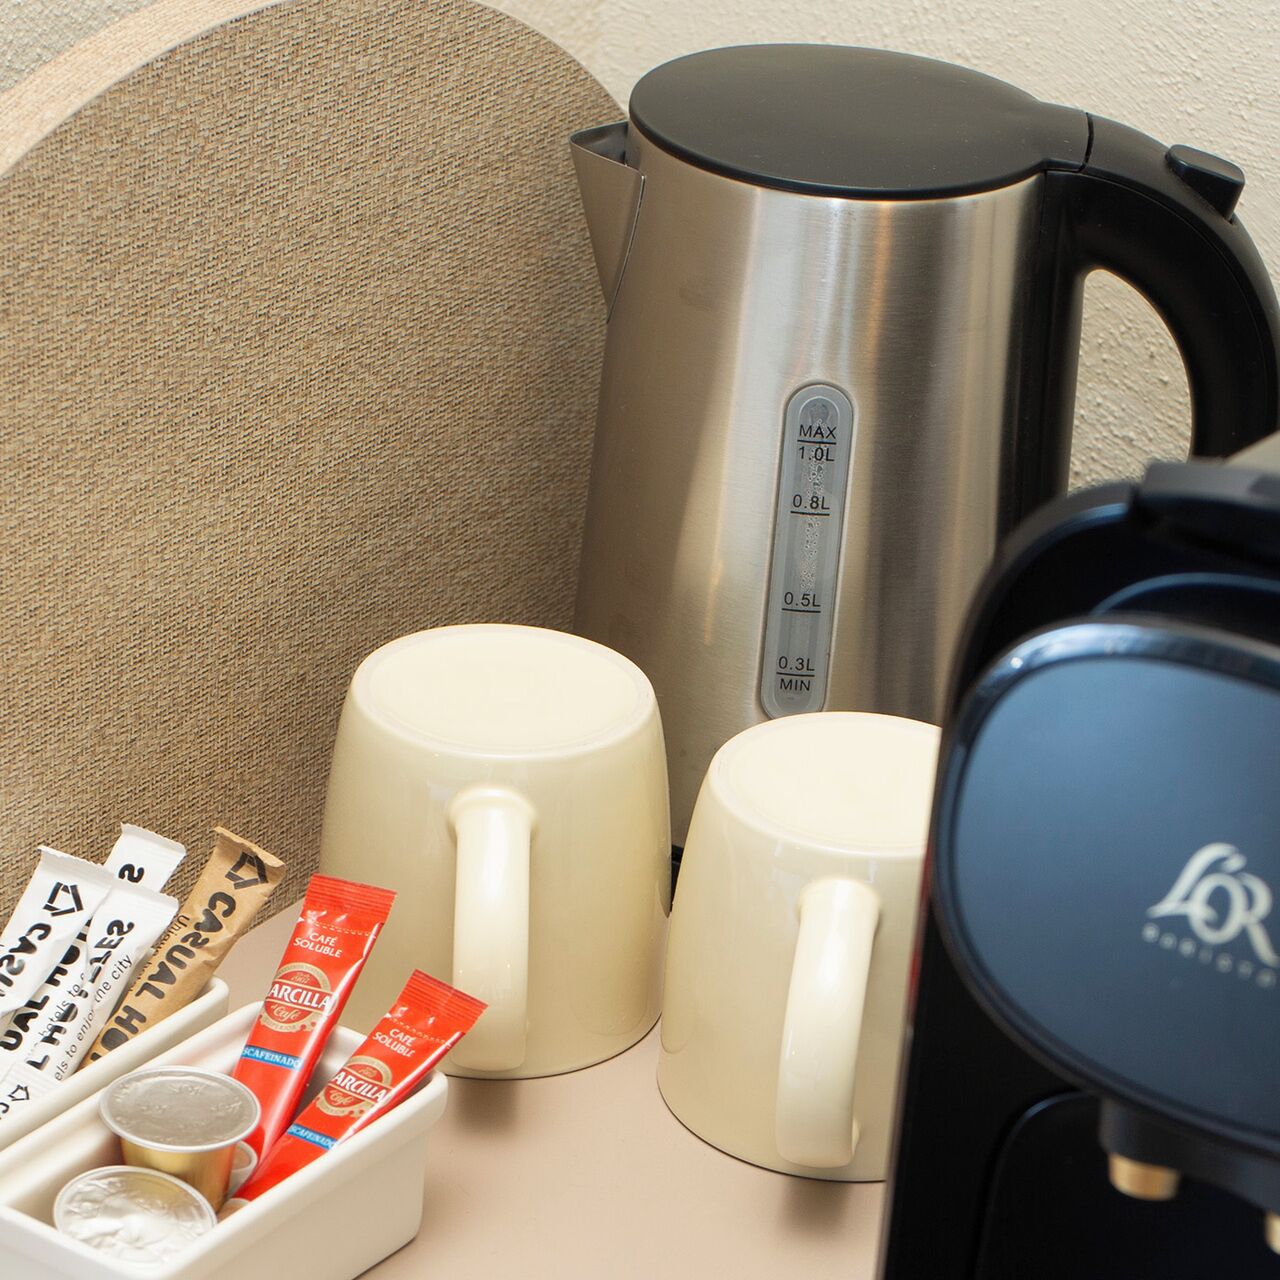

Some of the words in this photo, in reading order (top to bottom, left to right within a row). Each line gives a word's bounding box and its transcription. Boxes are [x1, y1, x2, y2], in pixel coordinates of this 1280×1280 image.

[799, 424, 837, 440] MAX
[799, 446, 835, 462] 1.0L
[792, 494, 830, 510] 0.8L
[784, 592, 821, 608] 0.5L
[778, 656, 815, 672] 0.3L
[780, 678, 811, 692] MIN
[135, 891, 236, 1000] CASUAL
[293, 937, 342, 958] SOLUBLE
[309, 932, 337, 947] CAFÉ
[112, 954, 134, 981] city
